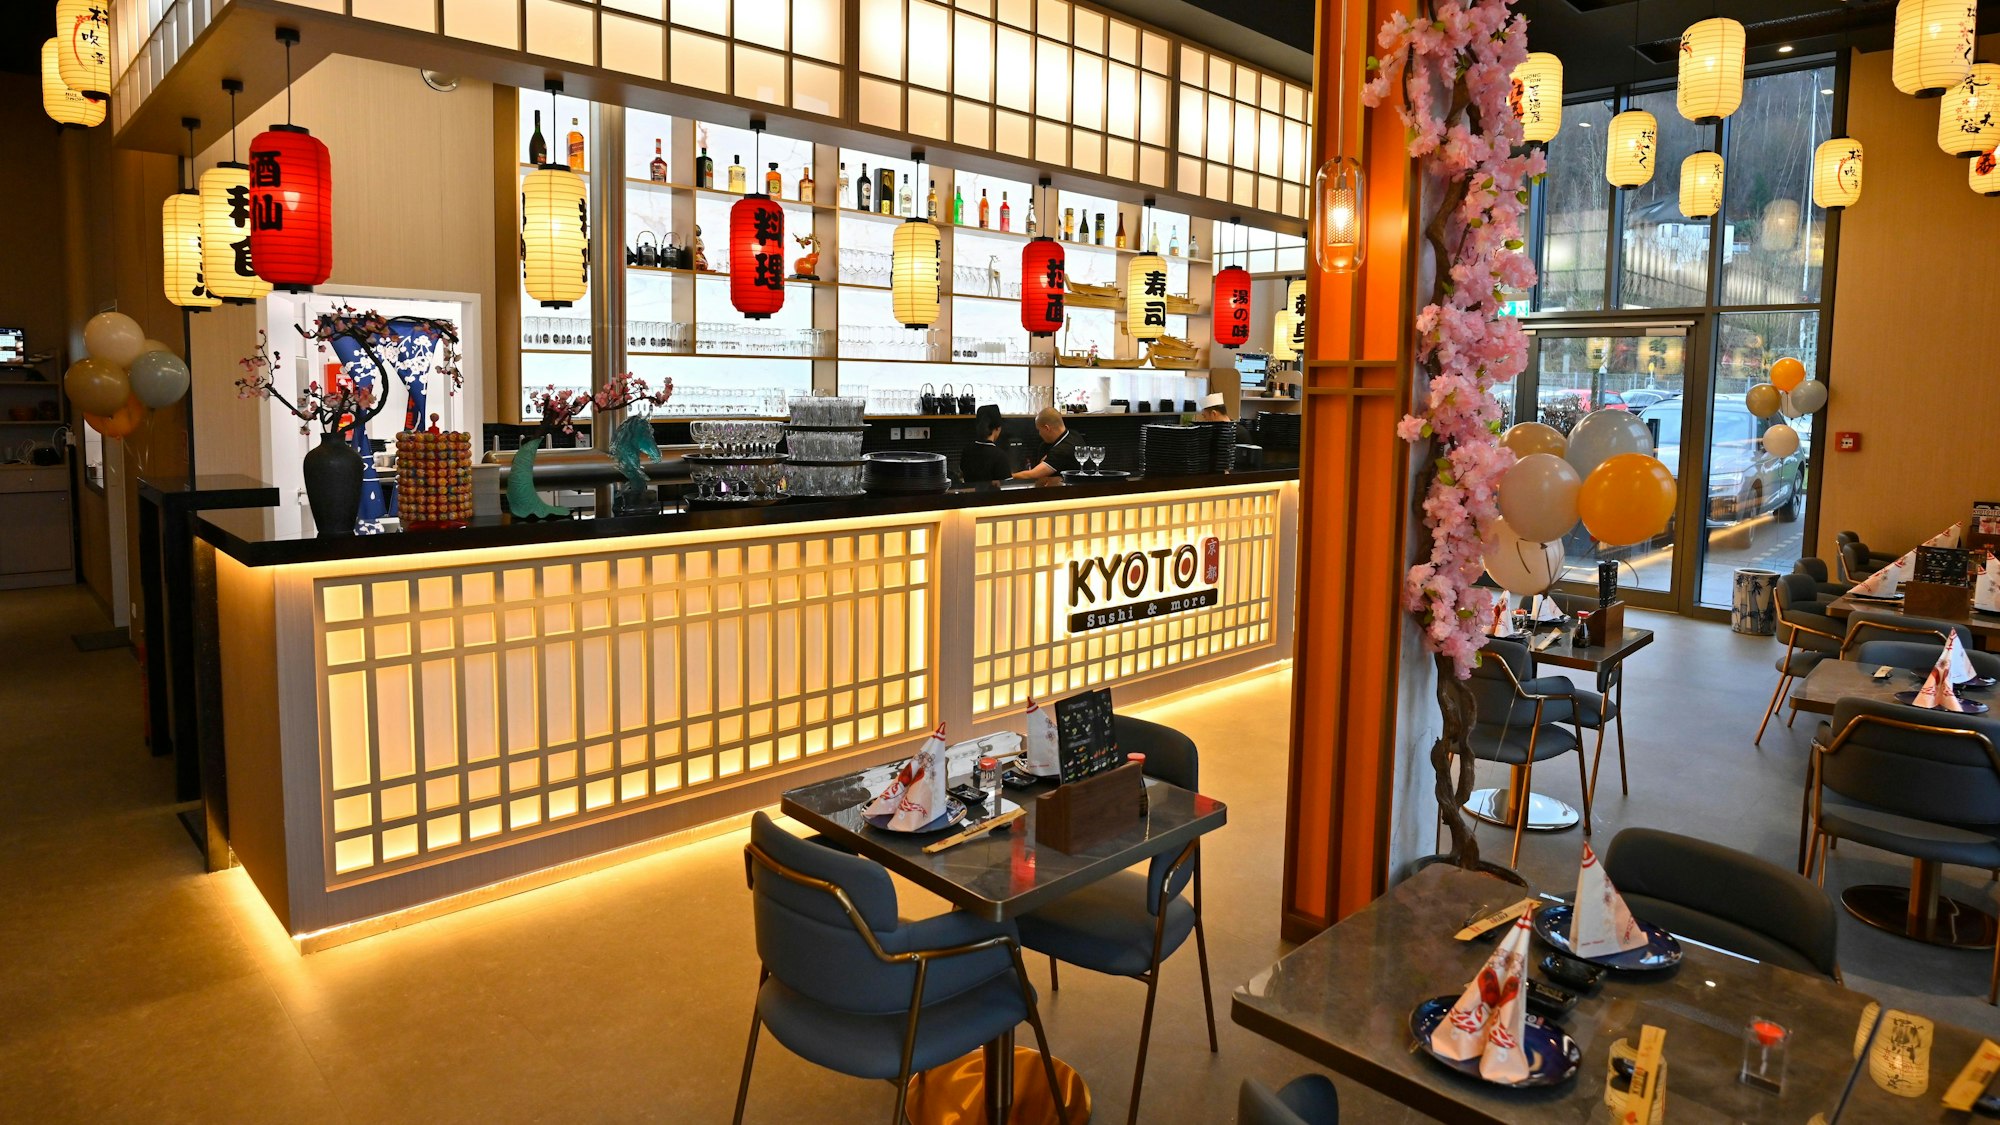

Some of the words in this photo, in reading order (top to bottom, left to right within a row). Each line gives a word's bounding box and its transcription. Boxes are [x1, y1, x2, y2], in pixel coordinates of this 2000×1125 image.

[251, 150, 283, 232] 酒仙
[753, 207, 785, 291] 料理
[1144, 270, 1167, 327] 寿司
[1232, 289, 1249, 338] 湯の味
[1069, 543, 1198, 608] KYOTO
[1206, 539, 1218, 581] 京都
[1086, 607, 1134, 628] Sushi
[1147, 602, 1158, 616] &
[1170, 594, 1207, 612] more
